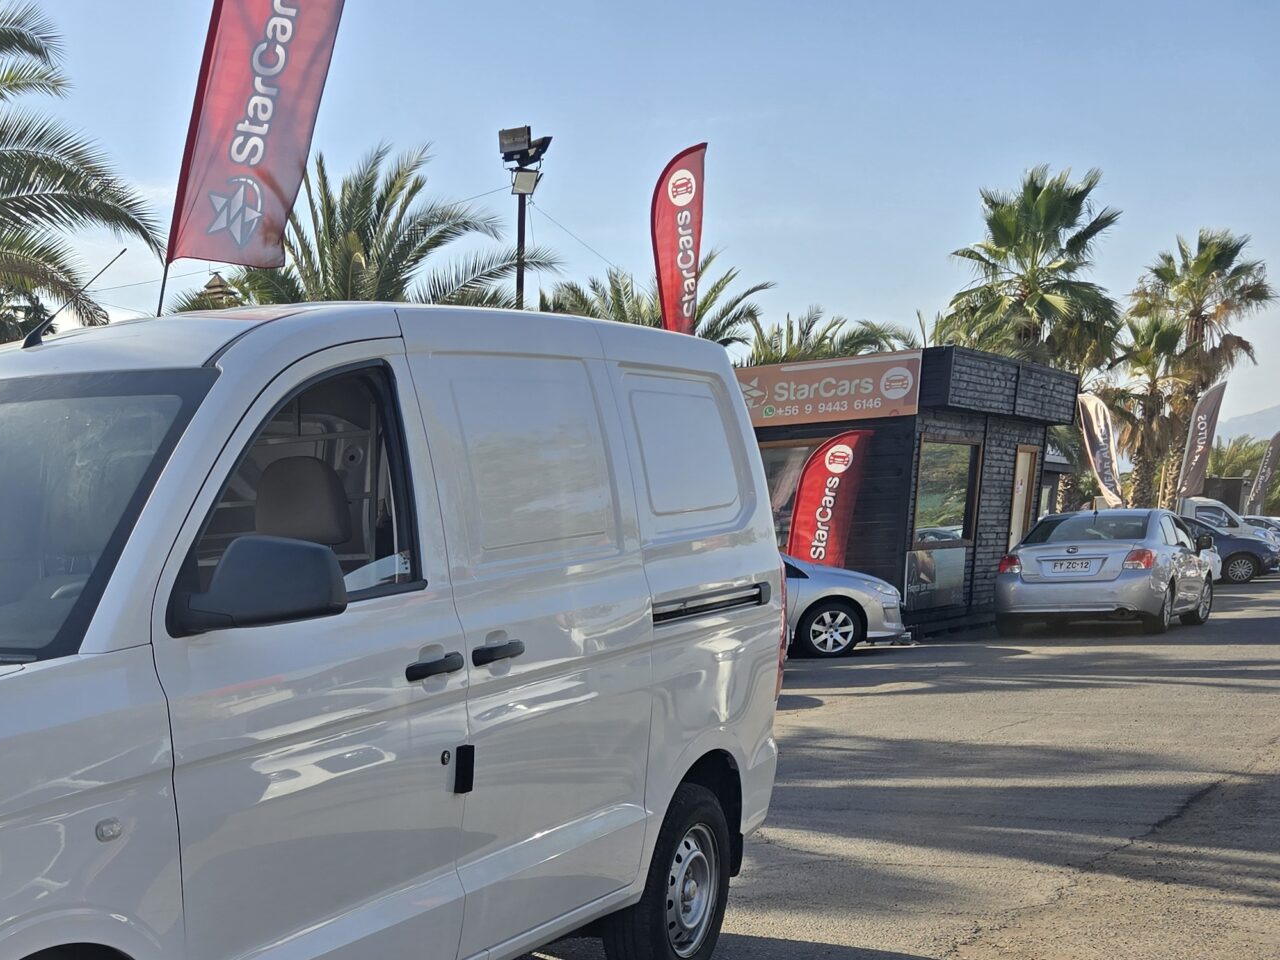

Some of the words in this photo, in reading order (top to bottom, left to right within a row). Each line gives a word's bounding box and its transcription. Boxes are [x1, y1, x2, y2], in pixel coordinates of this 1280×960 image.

[231, 0, 297, 165] StarCar
[677, 210, 696, 318] StarCars
[773, 377, 874, 402] StarCars
[777, 405, 799, 416] +56
[805, 405, 813, 414] 9
[818, 401, 848, 412] 9443
[854, 398, 882, 410] 6146
[810, 476, 840, 560] StarCars
